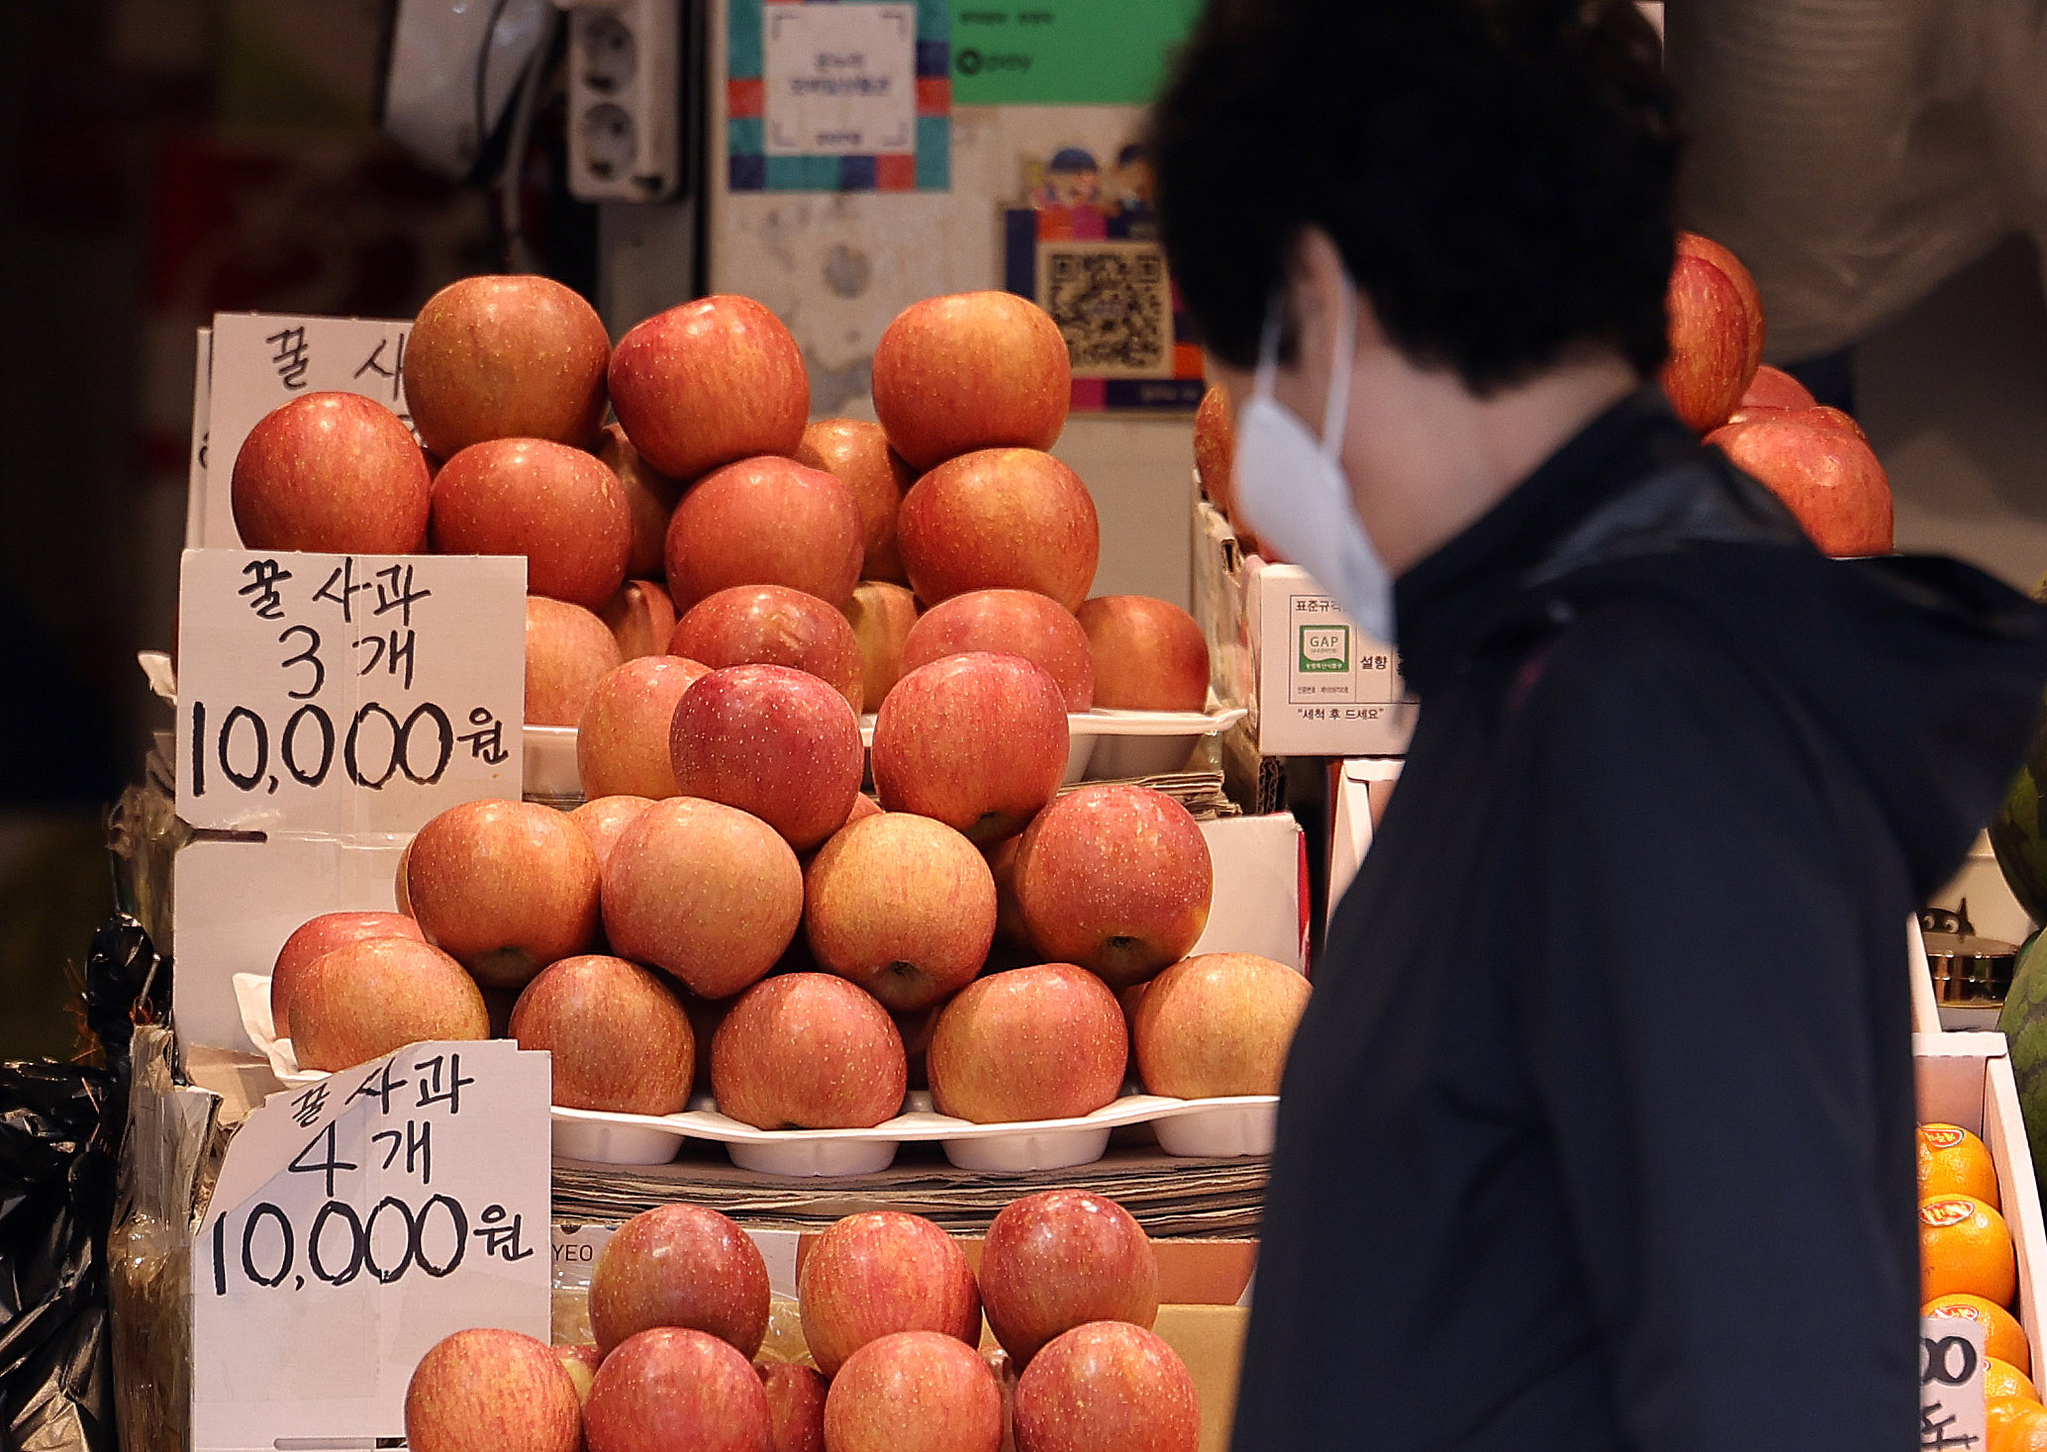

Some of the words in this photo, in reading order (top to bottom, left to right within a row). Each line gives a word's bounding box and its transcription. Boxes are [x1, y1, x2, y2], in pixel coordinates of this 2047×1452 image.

[266, 325, 309, 391] 꿀
[238, 557, 293, 620] 꿀
[312, 556, 431, 626] 사과
[278, 624, 325, 700] 3
[351, 629, 416, 691] 개
[1309, 636, 1339, 648] GAP
[1360, 655, 1388, 670] 설향
[192, 701, 509, 798] 10,000원
[1329, 708, 1341, 721] 후
[291, 1083, 330, 1127] 꿀
[345, 1053, 474, 1115] 사과
[287, 1118, 358, 1198] 4
[371, 1119, 431, 1185] 개
[212, 1193, 534, 1296] 10,000원
[552, 1244, 593, 1262] YEO
